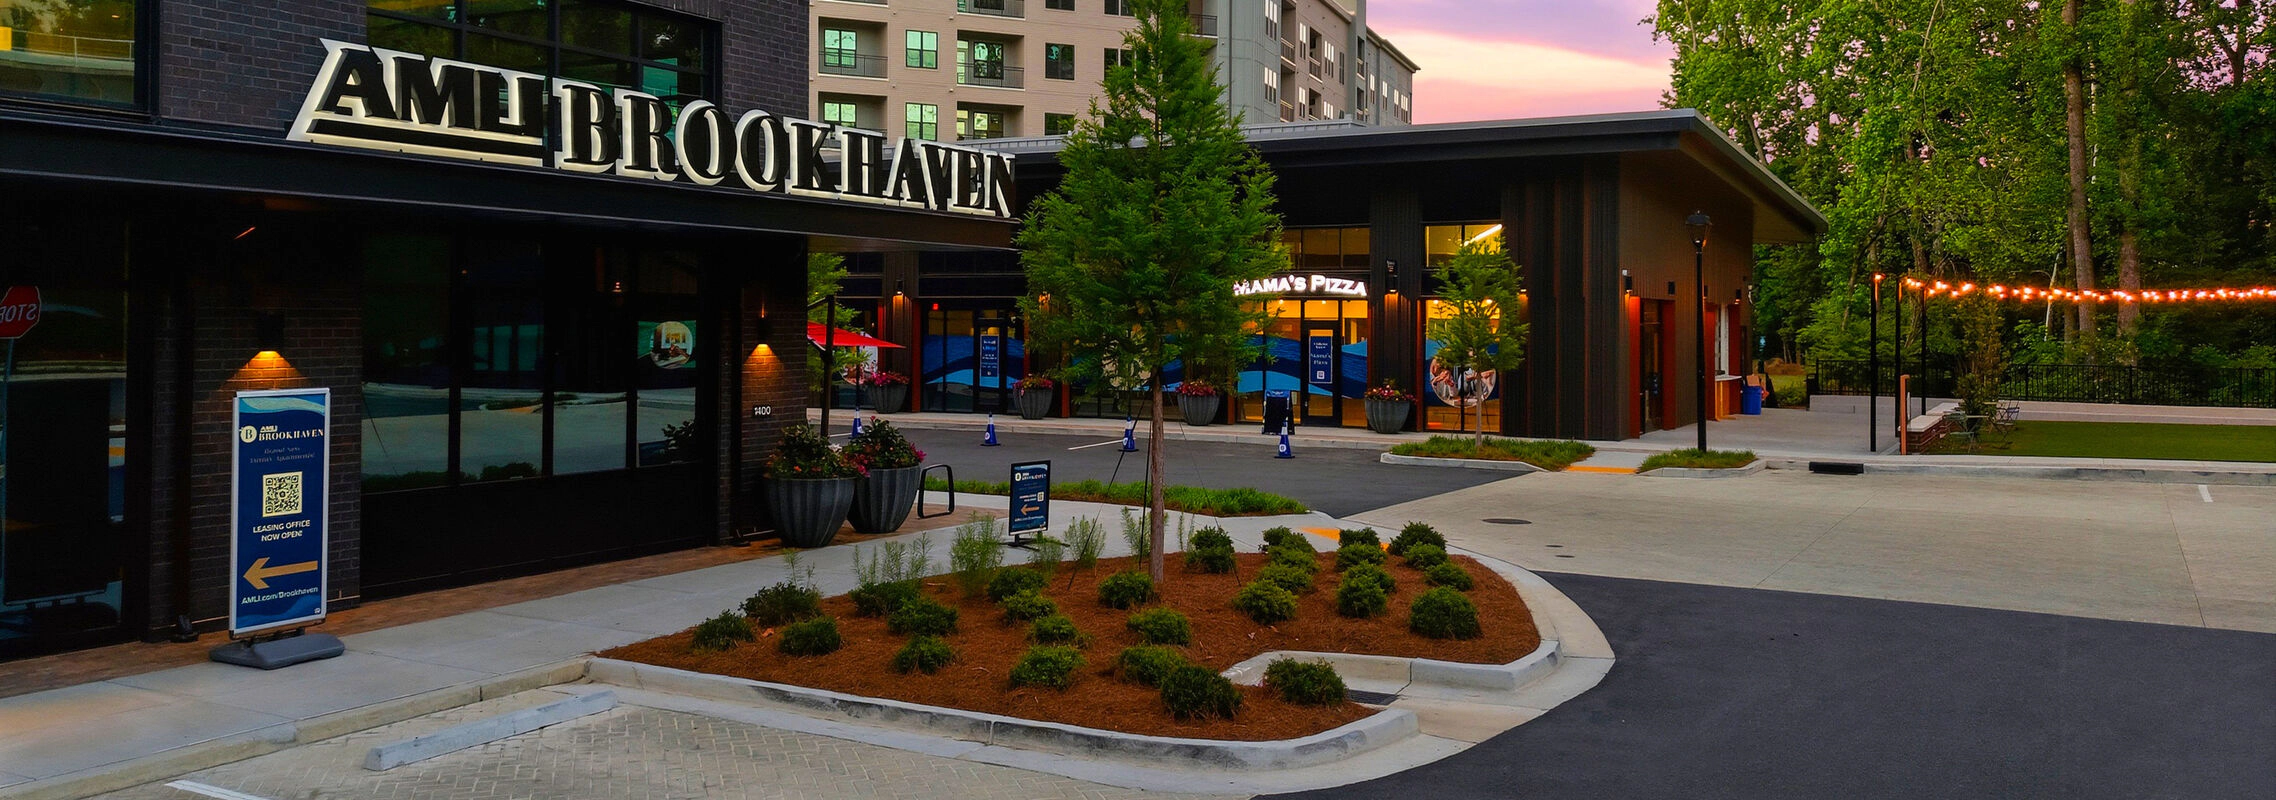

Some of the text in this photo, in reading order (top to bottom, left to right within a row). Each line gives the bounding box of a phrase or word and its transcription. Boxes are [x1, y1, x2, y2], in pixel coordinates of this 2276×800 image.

[306, 42, 1016, 218] AMLI BROOKHAVEN
[1310, 274, 1368, 296] PIZZA
[258, 428, 324, 441] BROOKHAVEN
[252, 519, 311, 534] LEASING OFFICE
[261, 533, 280, 542] NOW
[241, 586, 318, 604] AMLI.com/Brookhaven
